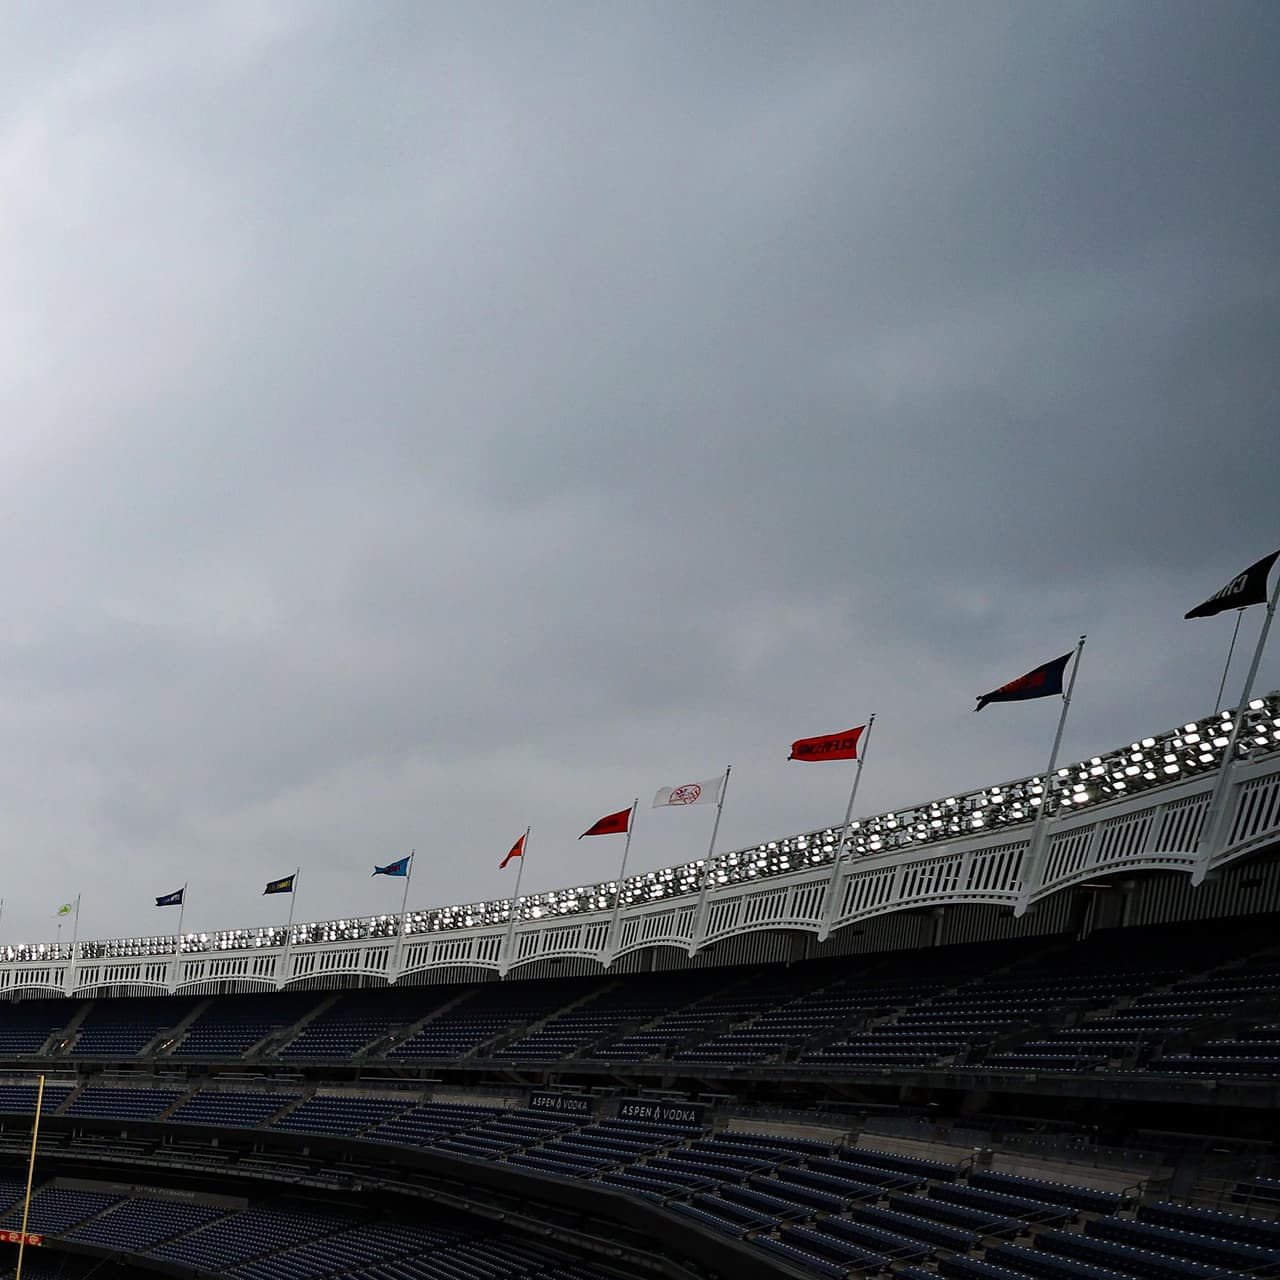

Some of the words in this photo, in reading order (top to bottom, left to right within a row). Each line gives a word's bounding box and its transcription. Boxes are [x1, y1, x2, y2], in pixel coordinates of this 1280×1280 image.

[531, 1097, 555, 1108] ASPEN
[563, 1100, 588, 1111] VODKA
[621, 1105, 652, 1117] ASPEN
[663, 1110, 696, 1122] VODKA
